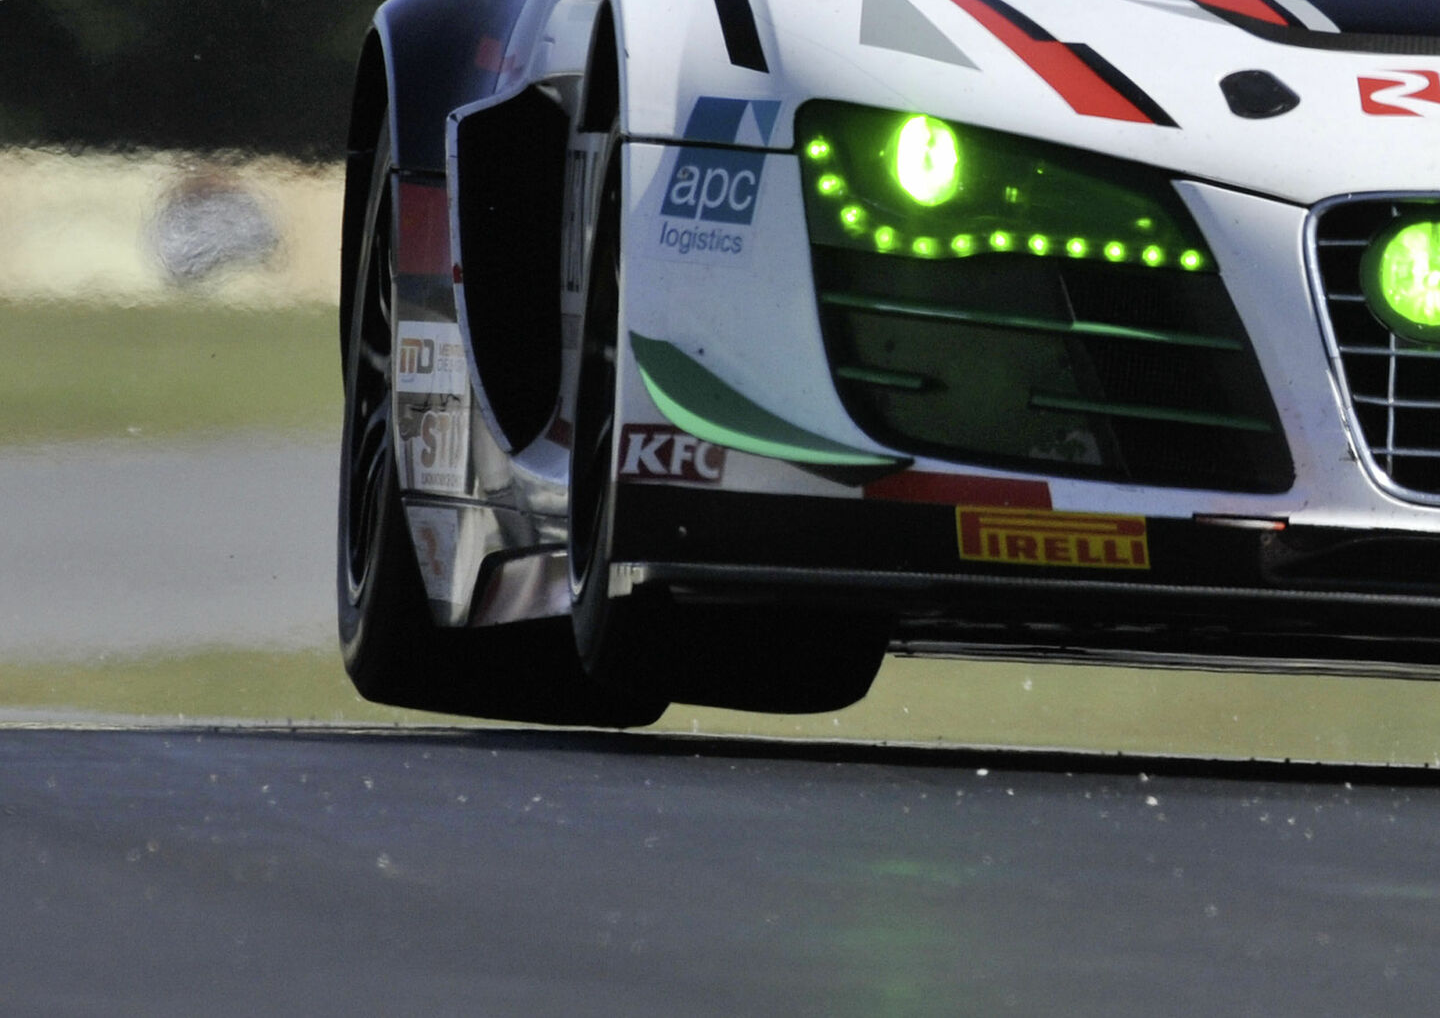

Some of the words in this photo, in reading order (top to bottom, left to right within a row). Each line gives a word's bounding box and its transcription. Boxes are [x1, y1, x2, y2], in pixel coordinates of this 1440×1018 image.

[671, 165, 756, 220] apc
[660, 221, 743, 254] logistics
[620, 434, 721, 479] KFC
[961, 511, 1146, 565] PIRELLI
